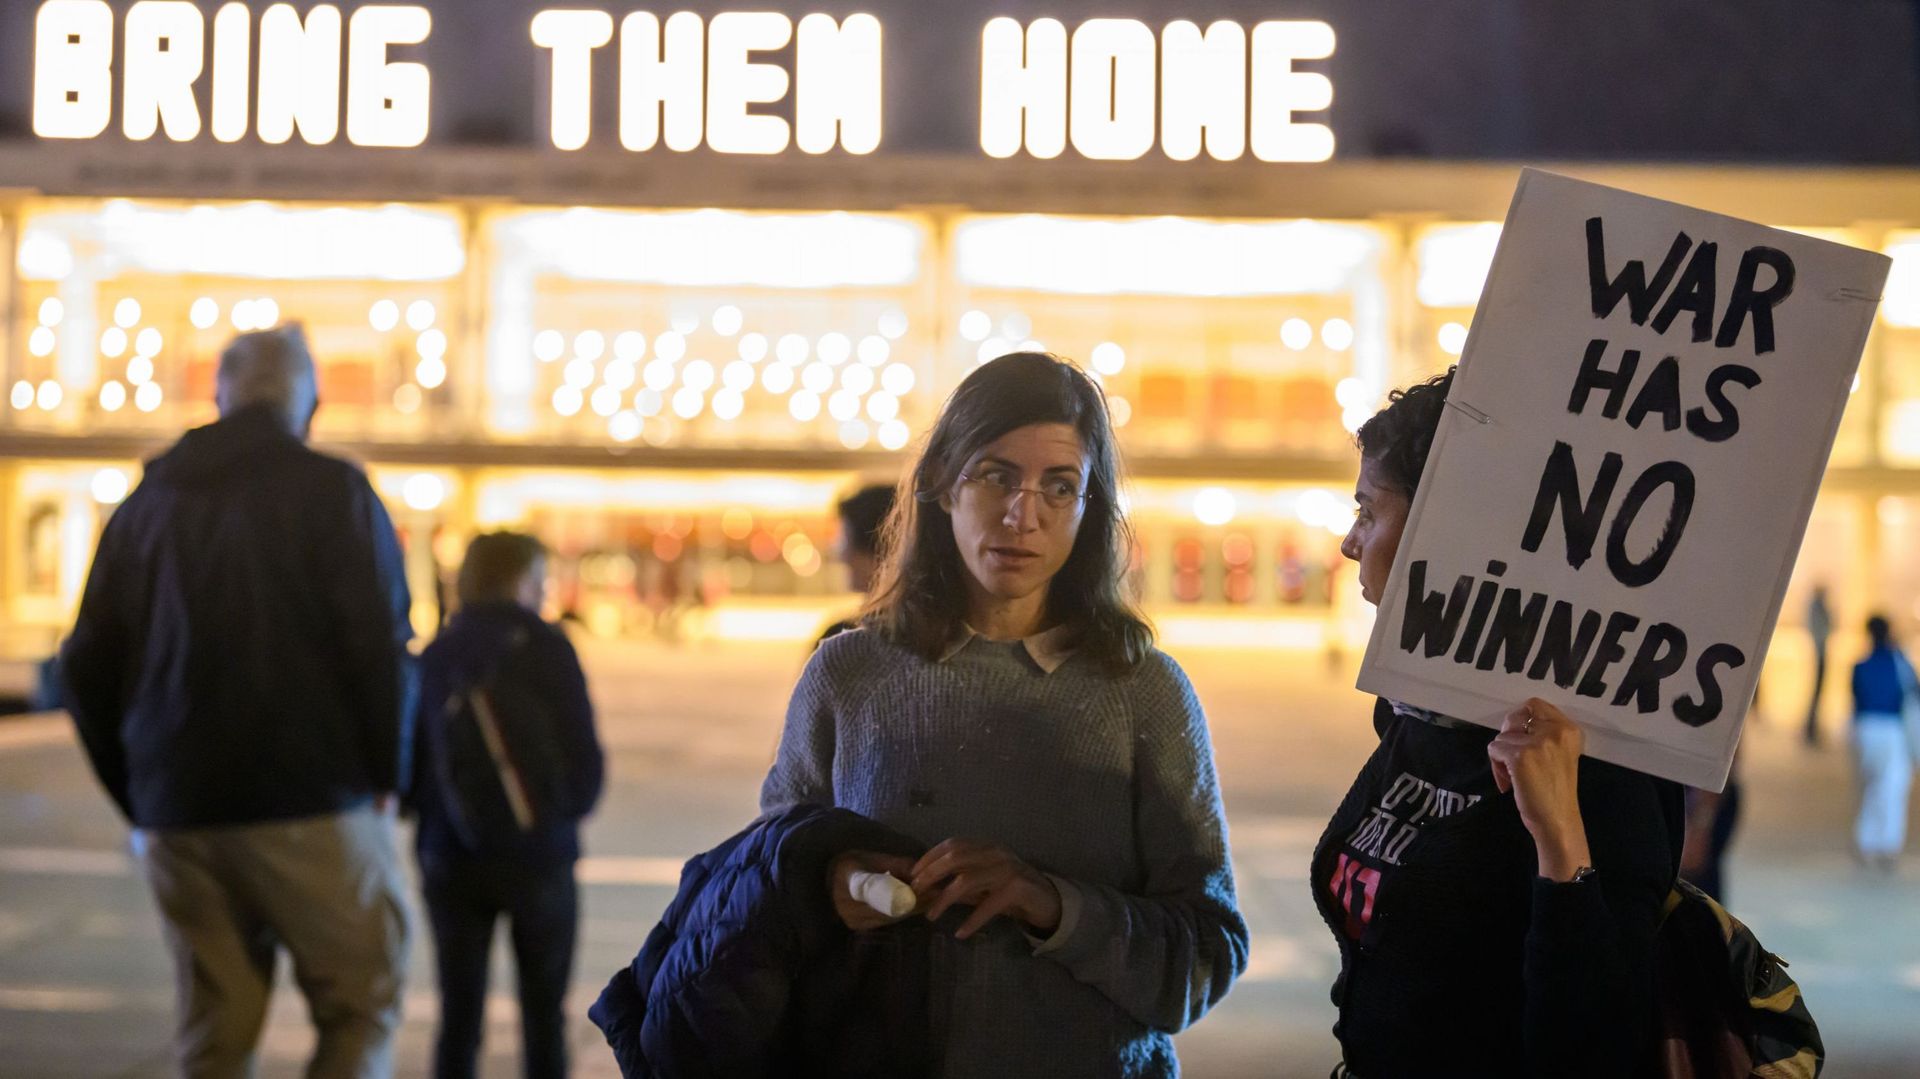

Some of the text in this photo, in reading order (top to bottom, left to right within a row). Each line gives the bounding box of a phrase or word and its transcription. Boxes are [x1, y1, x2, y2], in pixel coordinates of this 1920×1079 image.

[33, 0, 1335, 162] BRING THEM HOME
[1586, 217, 1796, 356] WAR
[1567, 339, 1762, 442] HAS
[1521, 440, 1695, 588] NO
